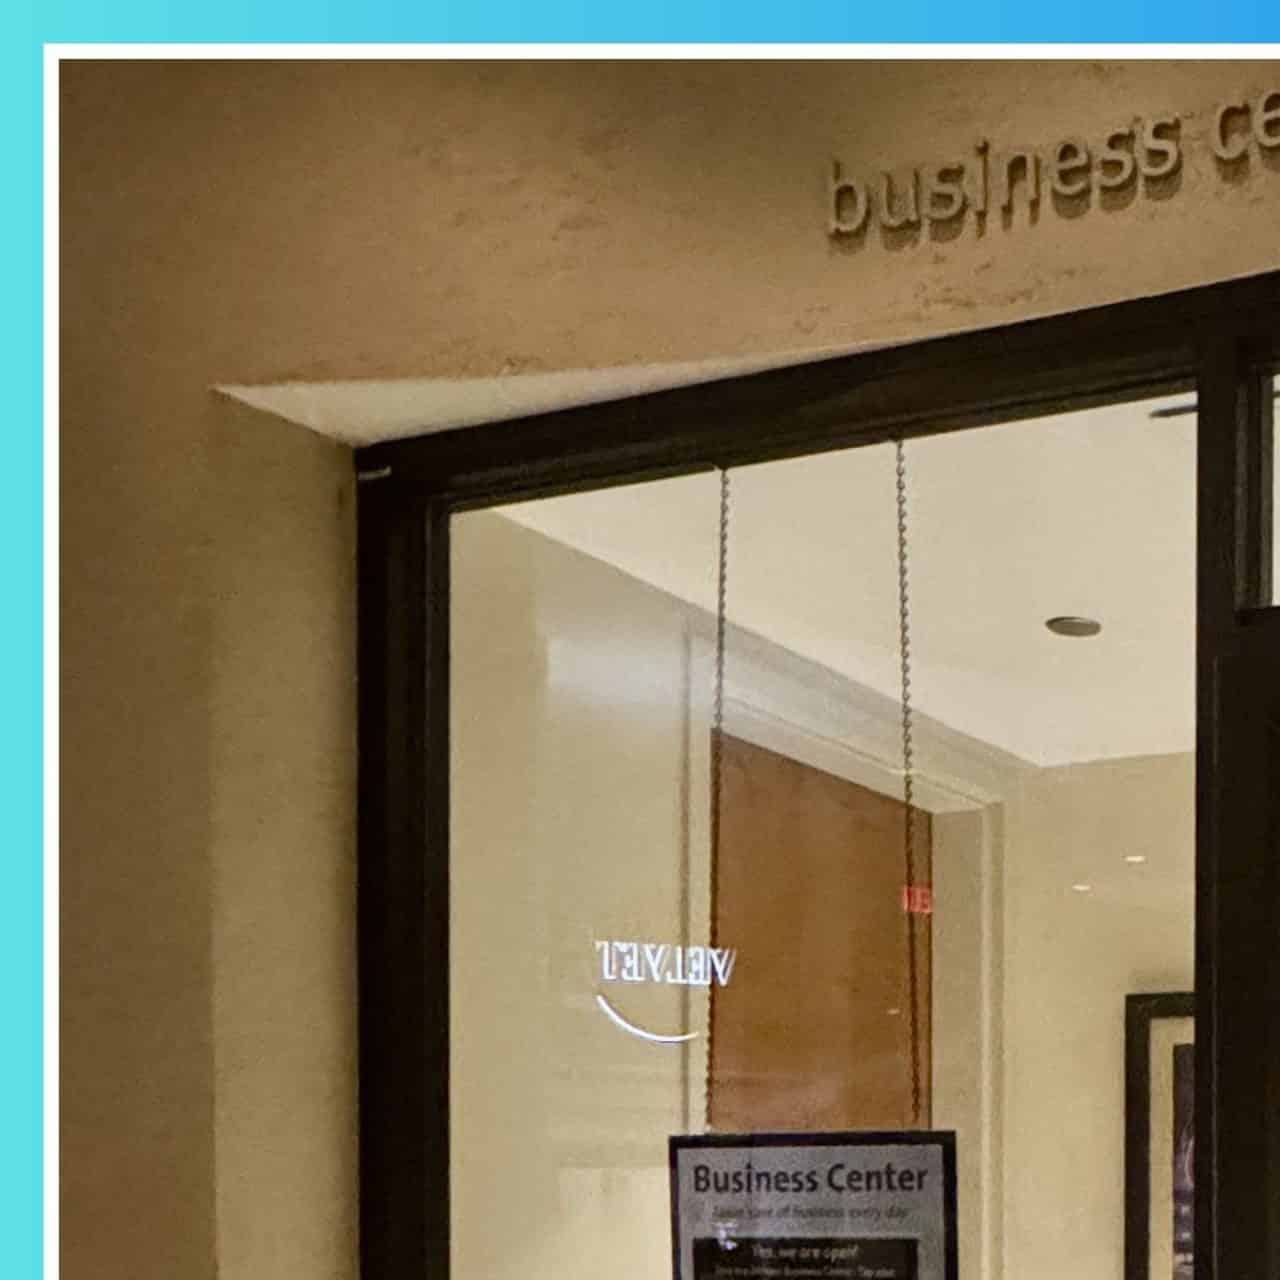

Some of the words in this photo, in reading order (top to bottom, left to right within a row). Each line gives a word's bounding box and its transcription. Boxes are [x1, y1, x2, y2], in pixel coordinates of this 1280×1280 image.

[826, 114, 1183, 242] business
[694, 1162, 819, 1194] Business
[827, 1162, 929, 1193] Center
